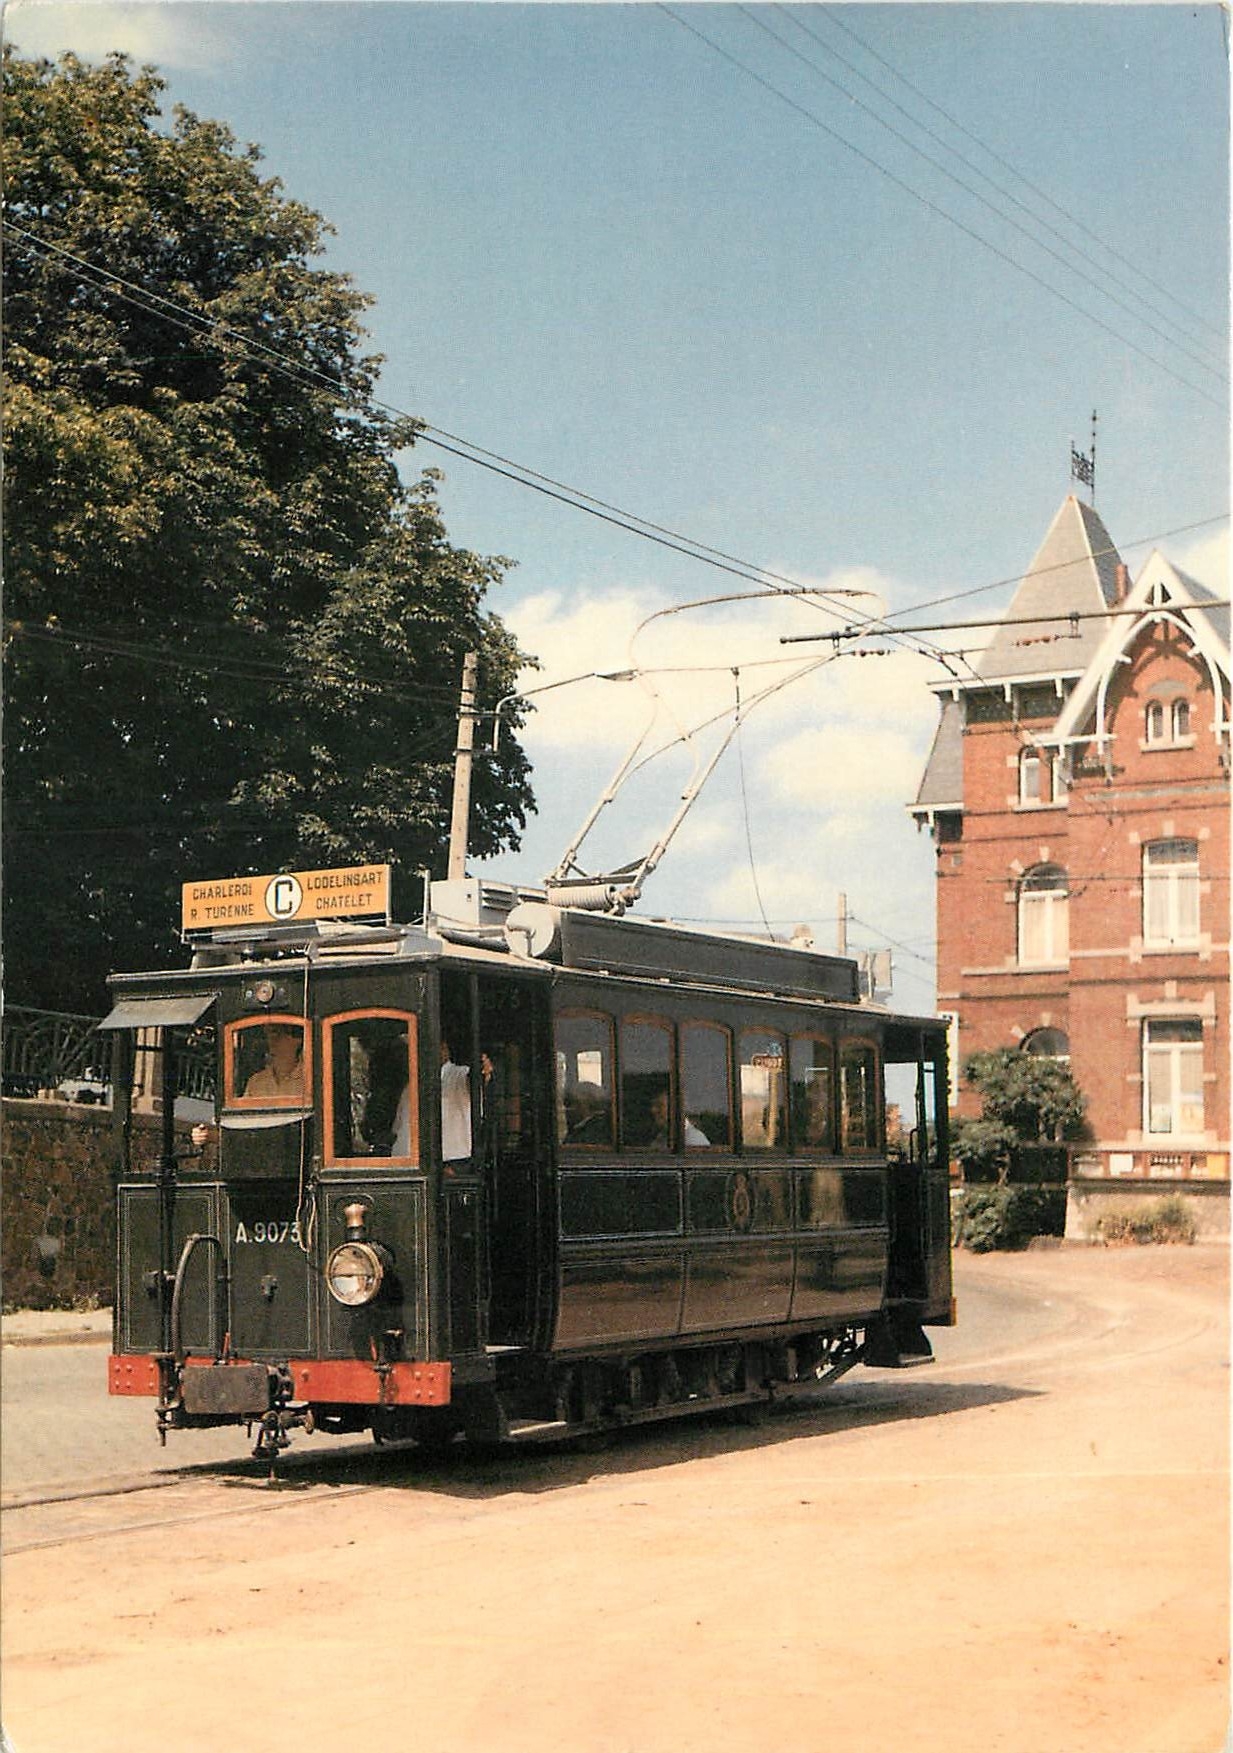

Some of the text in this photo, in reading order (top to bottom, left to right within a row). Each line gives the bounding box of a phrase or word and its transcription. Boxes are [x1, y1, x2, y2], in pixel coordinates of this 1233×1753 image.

[307, 871, 383, 890] LODELINSART
[192, 883, 252, 900] CHARLEROI
[274, 879, 293, 914] C
[316, 893, 373, 910] CHATELET
[205, 903, 255, 919] TURENNE
